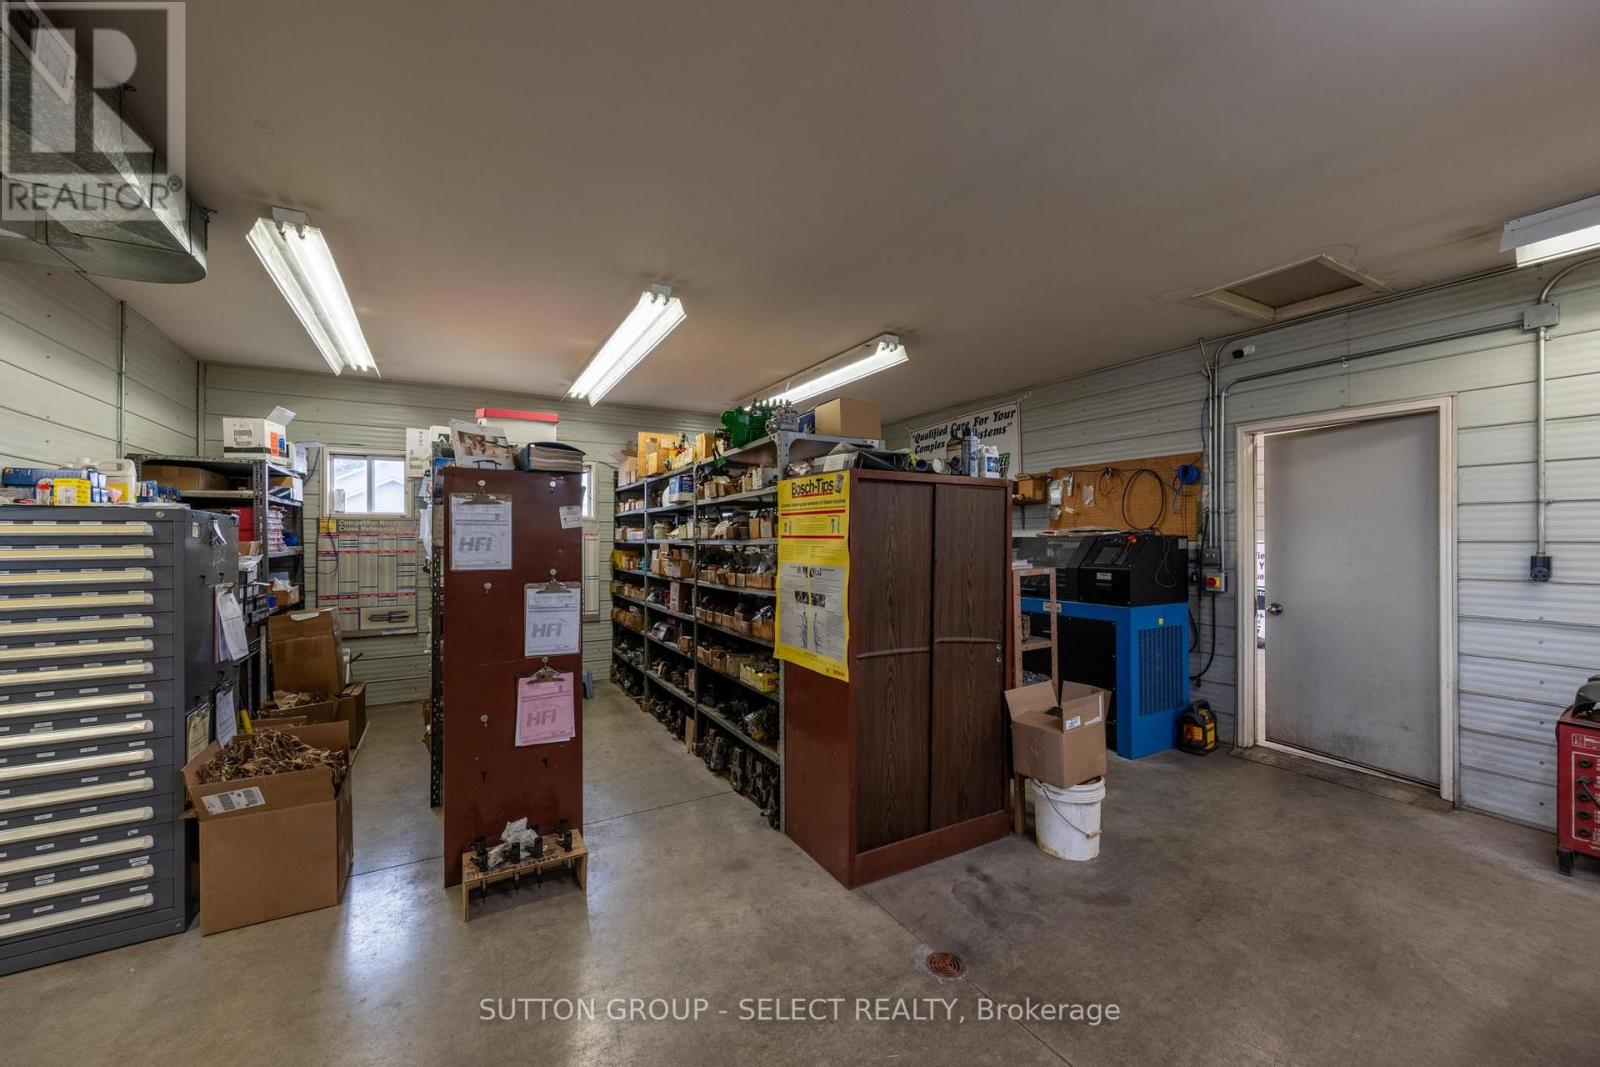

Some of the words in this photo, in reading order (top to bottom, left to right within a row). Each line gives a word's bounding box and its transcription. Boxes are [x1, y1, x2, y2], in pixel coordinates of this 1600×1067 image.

[973, 415, 989, 428] For
[992, 409, 1016, 423] Your
[914, 440, 945, 454] Complex
[791, 478, 834, 496] Bosch-Tips
[459, 536, 493, 552] HFI
[531, 622, 563, 638] HFI
[526, 708, 557, 728] HFI
